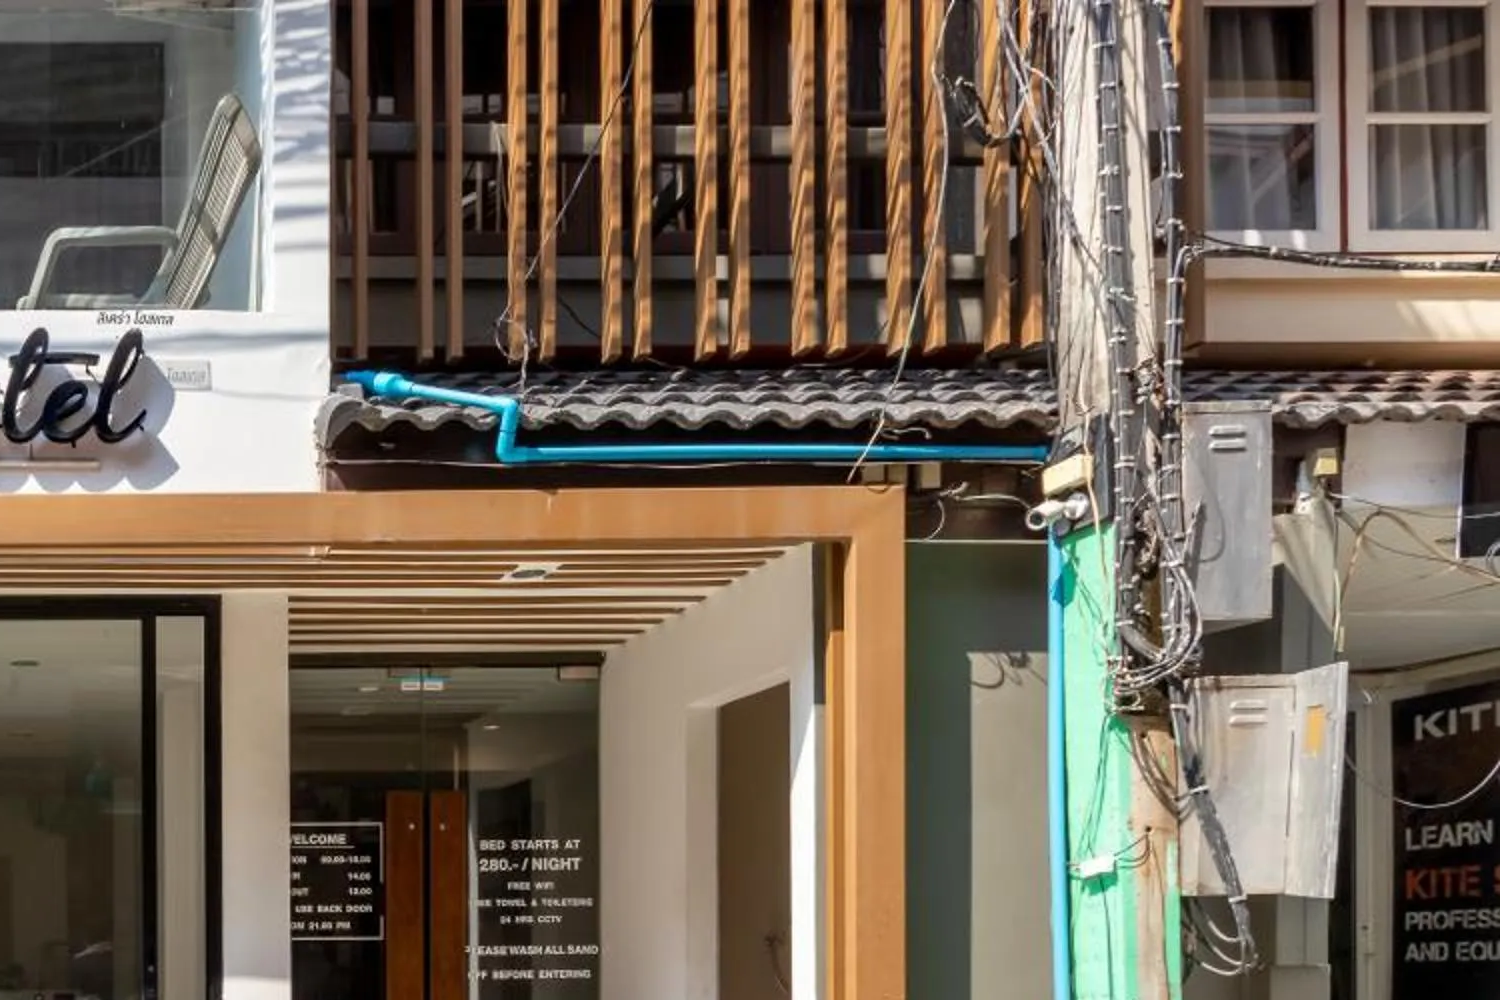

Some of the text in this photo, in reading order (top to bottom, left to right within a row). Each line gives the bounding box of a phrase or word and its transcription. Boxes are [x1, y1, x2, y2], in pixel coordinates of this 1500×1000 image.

[1414, 701, 1500, 741] KIT
[291, 834, 347, 844] ELCOME
[1405, 819, 1493, 851] LEARN
[479, 839, 581, 850] BED STARTS AT
[531, 858, 582, 871] NIGHT
[1405, 866, 1481, 901] KITE
[537, 915, 563, 924] CCTV
[544, 945, 565, 955] ALL
[1405, 941, 1449, 962] AND
